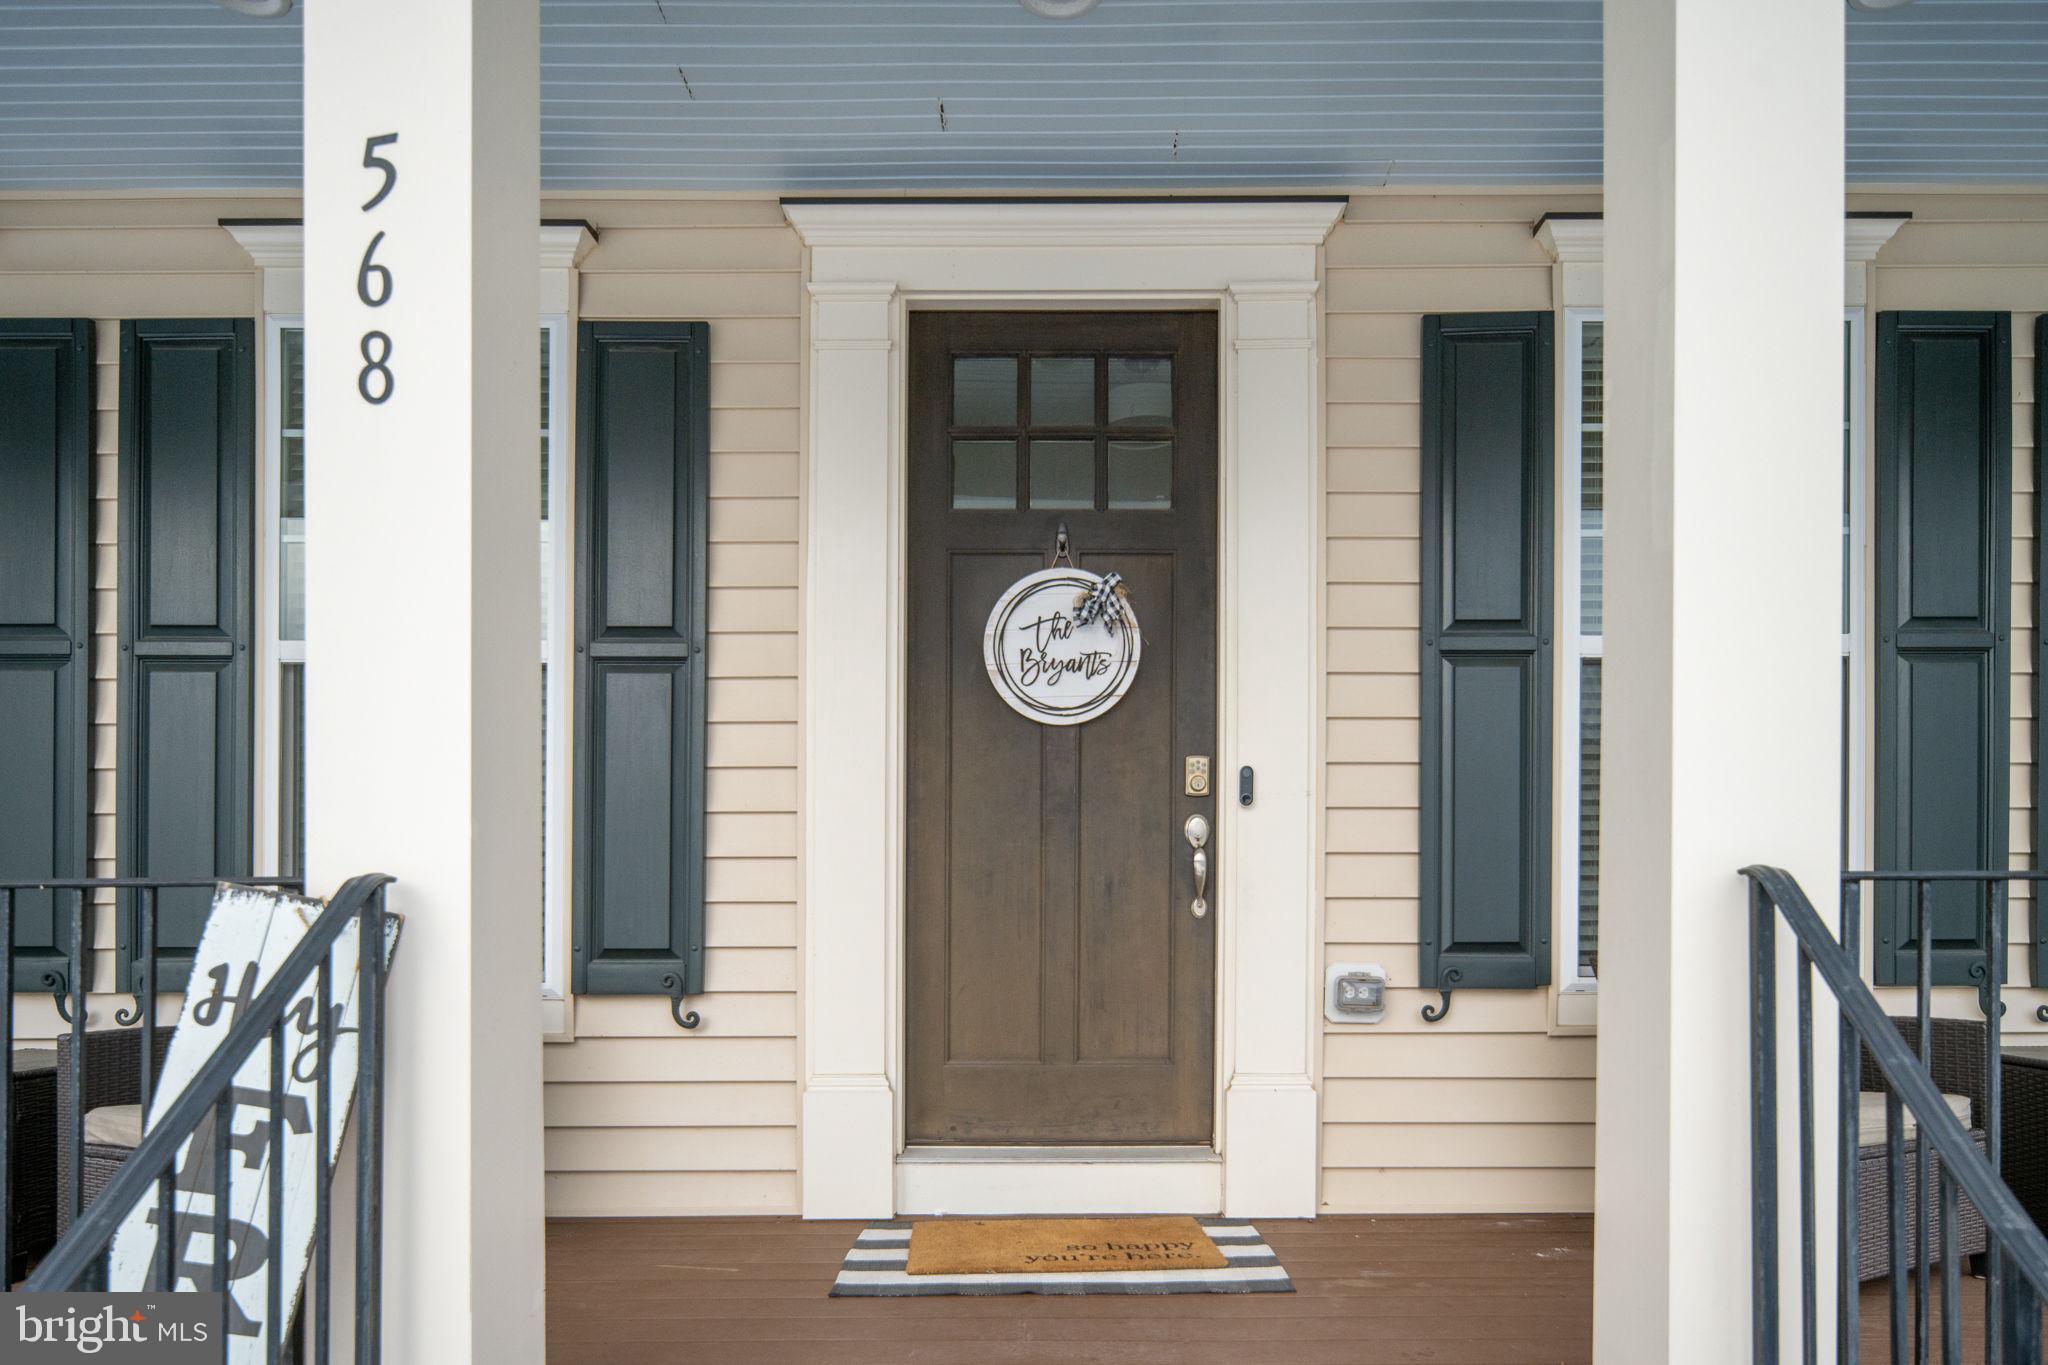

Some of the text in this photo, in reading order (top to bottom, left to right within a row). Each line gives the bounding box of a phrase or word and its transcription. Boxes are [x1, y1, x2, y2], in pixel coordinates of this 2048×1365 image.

[354, 131, 399, 405] 568
[1065, 1240, 1194, 1252] so happy
[1024, 1251, 1202, 1264] you're here.
